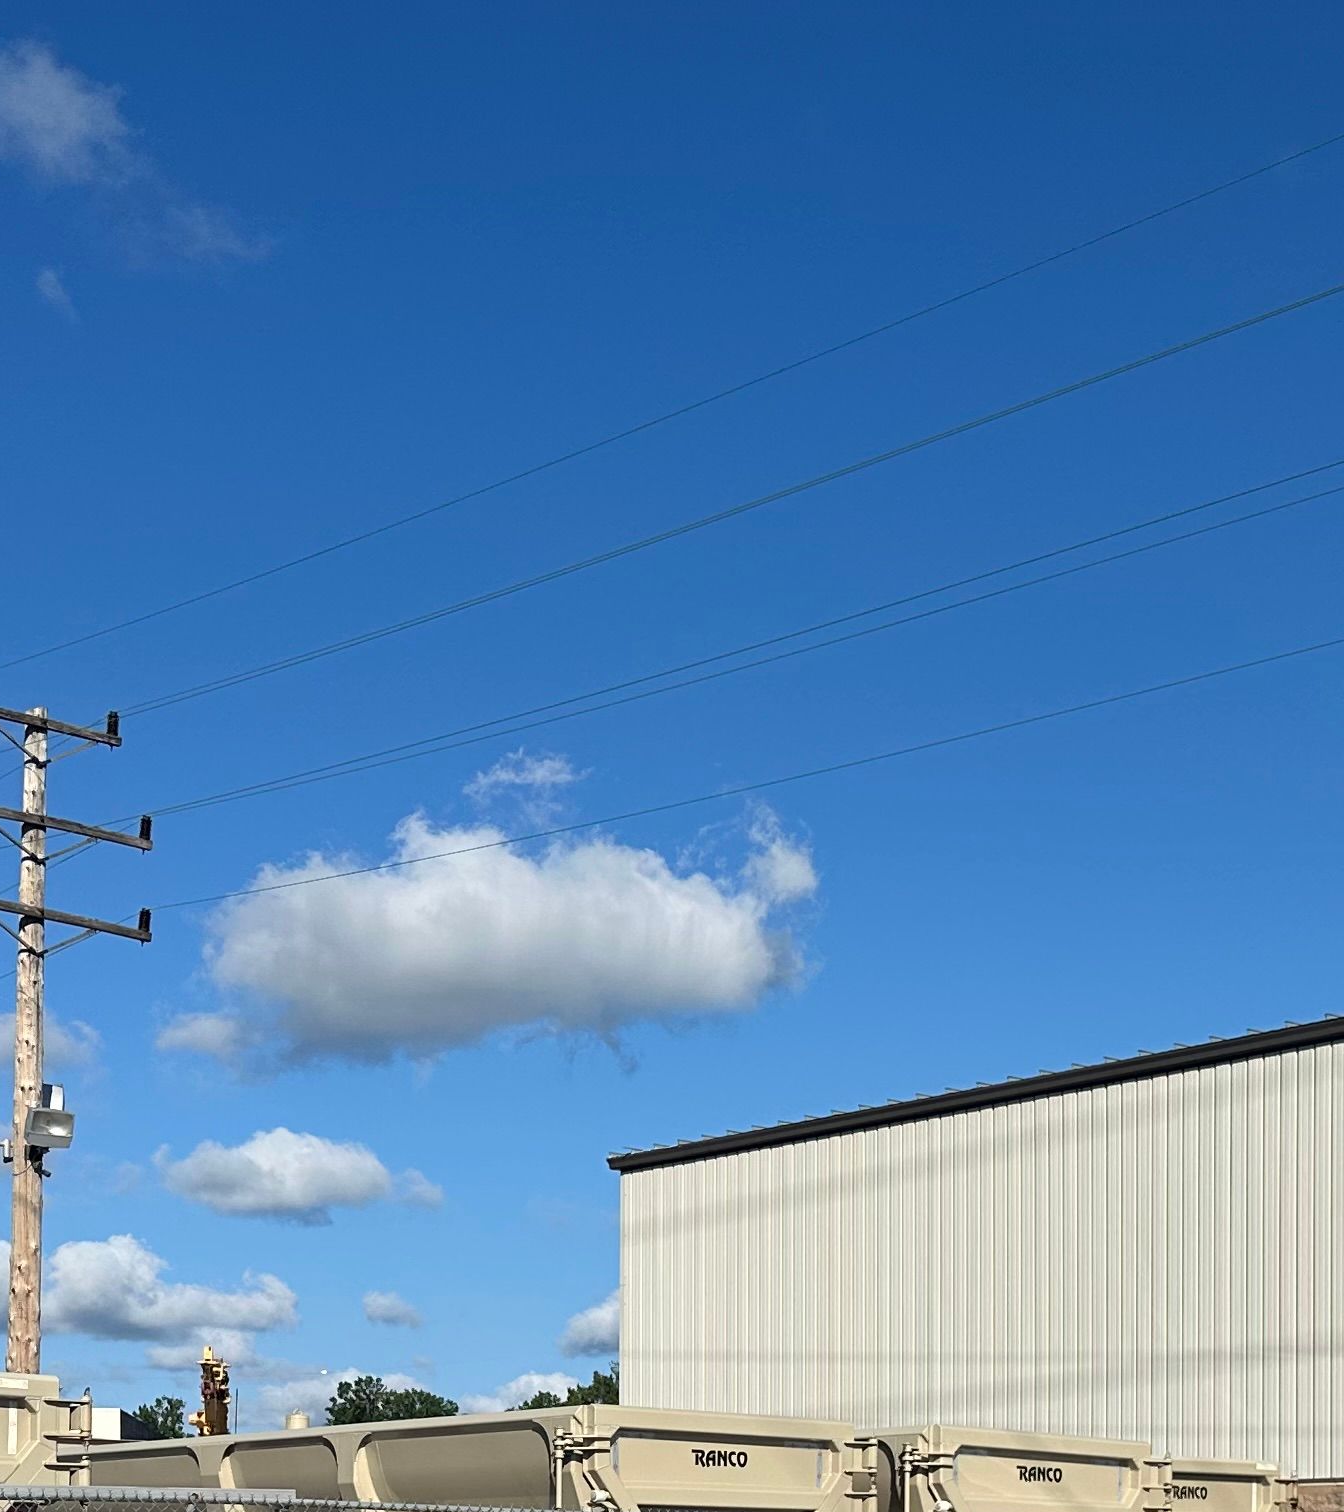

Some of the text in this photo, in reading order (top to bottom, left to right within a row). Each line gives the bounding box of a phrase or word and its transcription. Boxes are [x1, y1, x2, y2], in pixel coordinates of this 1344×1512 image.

[691, 1449, 748, 1468] RANCO
[1016, 1465, 1063, 1483] RANCO
[1172, 1485, 1208, 1501] RANCO
